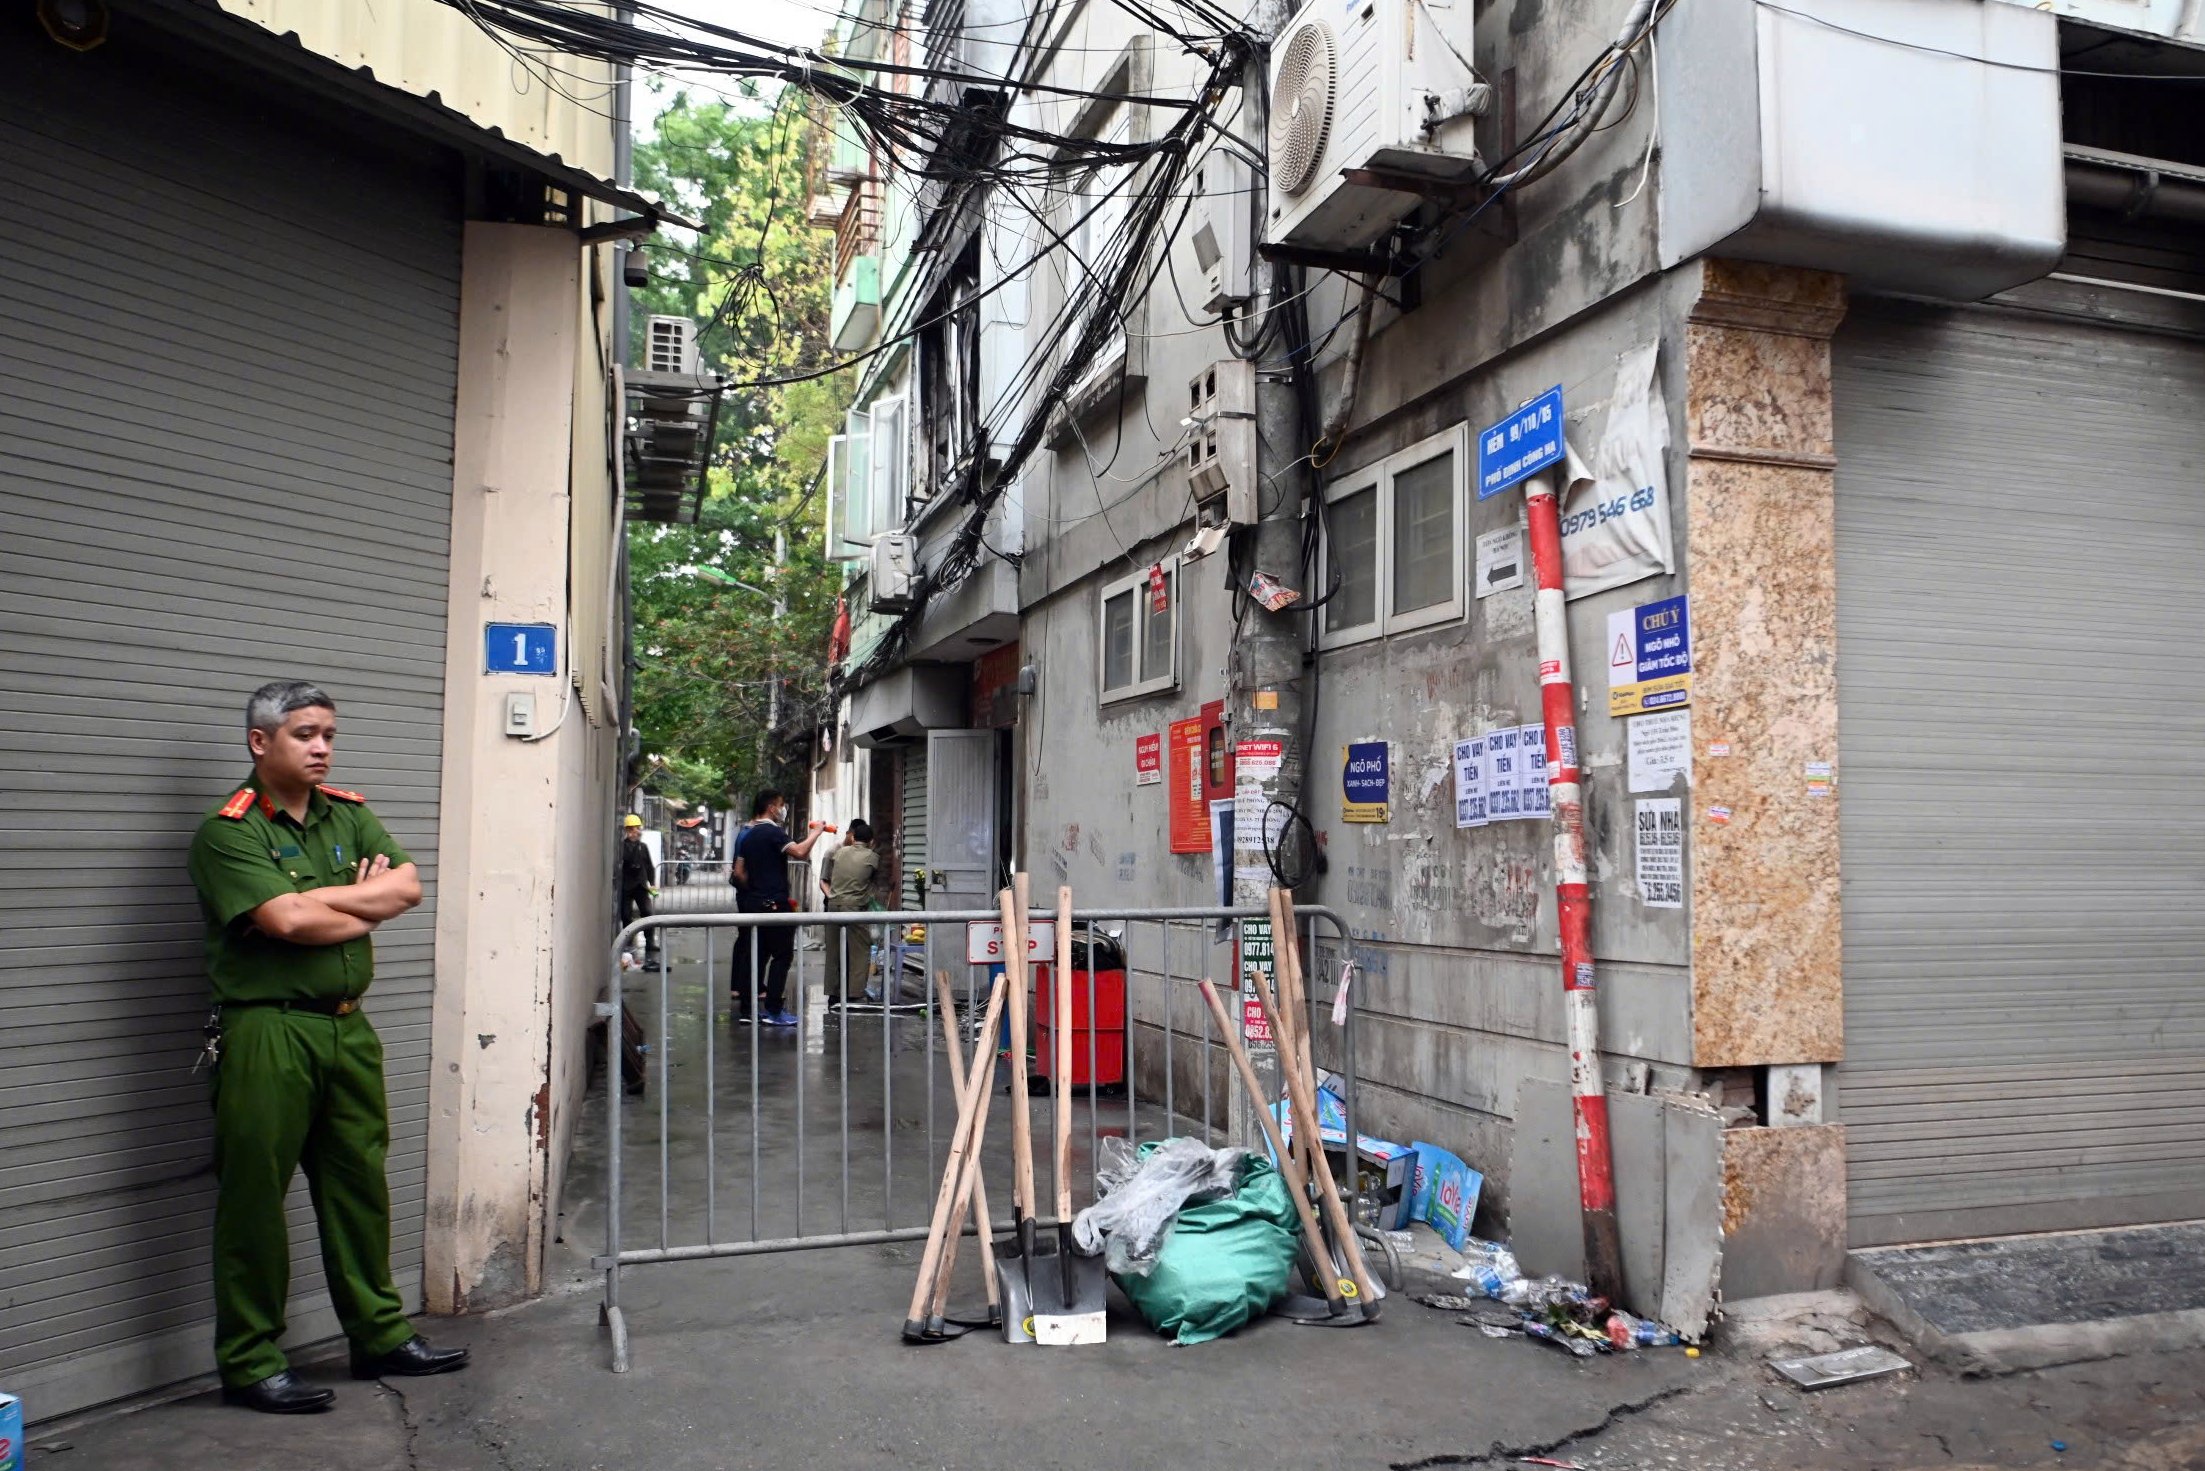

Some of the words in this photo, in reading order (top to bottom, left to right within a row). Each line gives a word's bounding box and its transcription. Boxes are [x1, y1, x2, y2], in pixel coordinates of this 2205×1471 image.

[1485, 465, 1502, 487] PHỐ
[1522, 447, 1544, 468] CÔNG
[1560, 508, 1596, 537] 0979
[1598, 495, 1627, 524] 546
[1643, 607, 1669, 630] CHÚ
[1670, 604, 1680, 624] Ý
[513, 633, 528, 666] 1
[1645, 637, 1662, 653] NGÕ
[1662, 633, 1680, 649] NHỎ
[1659, 653, 1675, 668] TỐC
[1675, 650, 1688, 667] ĐỘ
[1253, 743, 1272, 751] WIFI
[1489, 735, 1503, 751] CHO
[1504, 733, 1518, 749] VAY
[1524, 730, 1538, 746] CHO
[1457, 745, 1471, 761] CHO
[1471, 742, 1484, 758] VAY
[1350, 759, 1366, 773] NGÕ
[1366, 755, 1382, 772] PHỐ
[1243, 924, 1258, 935] CHO
[1258, 924, 1272, 935] VAY
[987, 940, 1038, 955] SP
[1243, 961, 1258, 972] CHO
[1258, 961, 1273, 972] VAY
[1247, 1006, 1262, 1019] CHO
